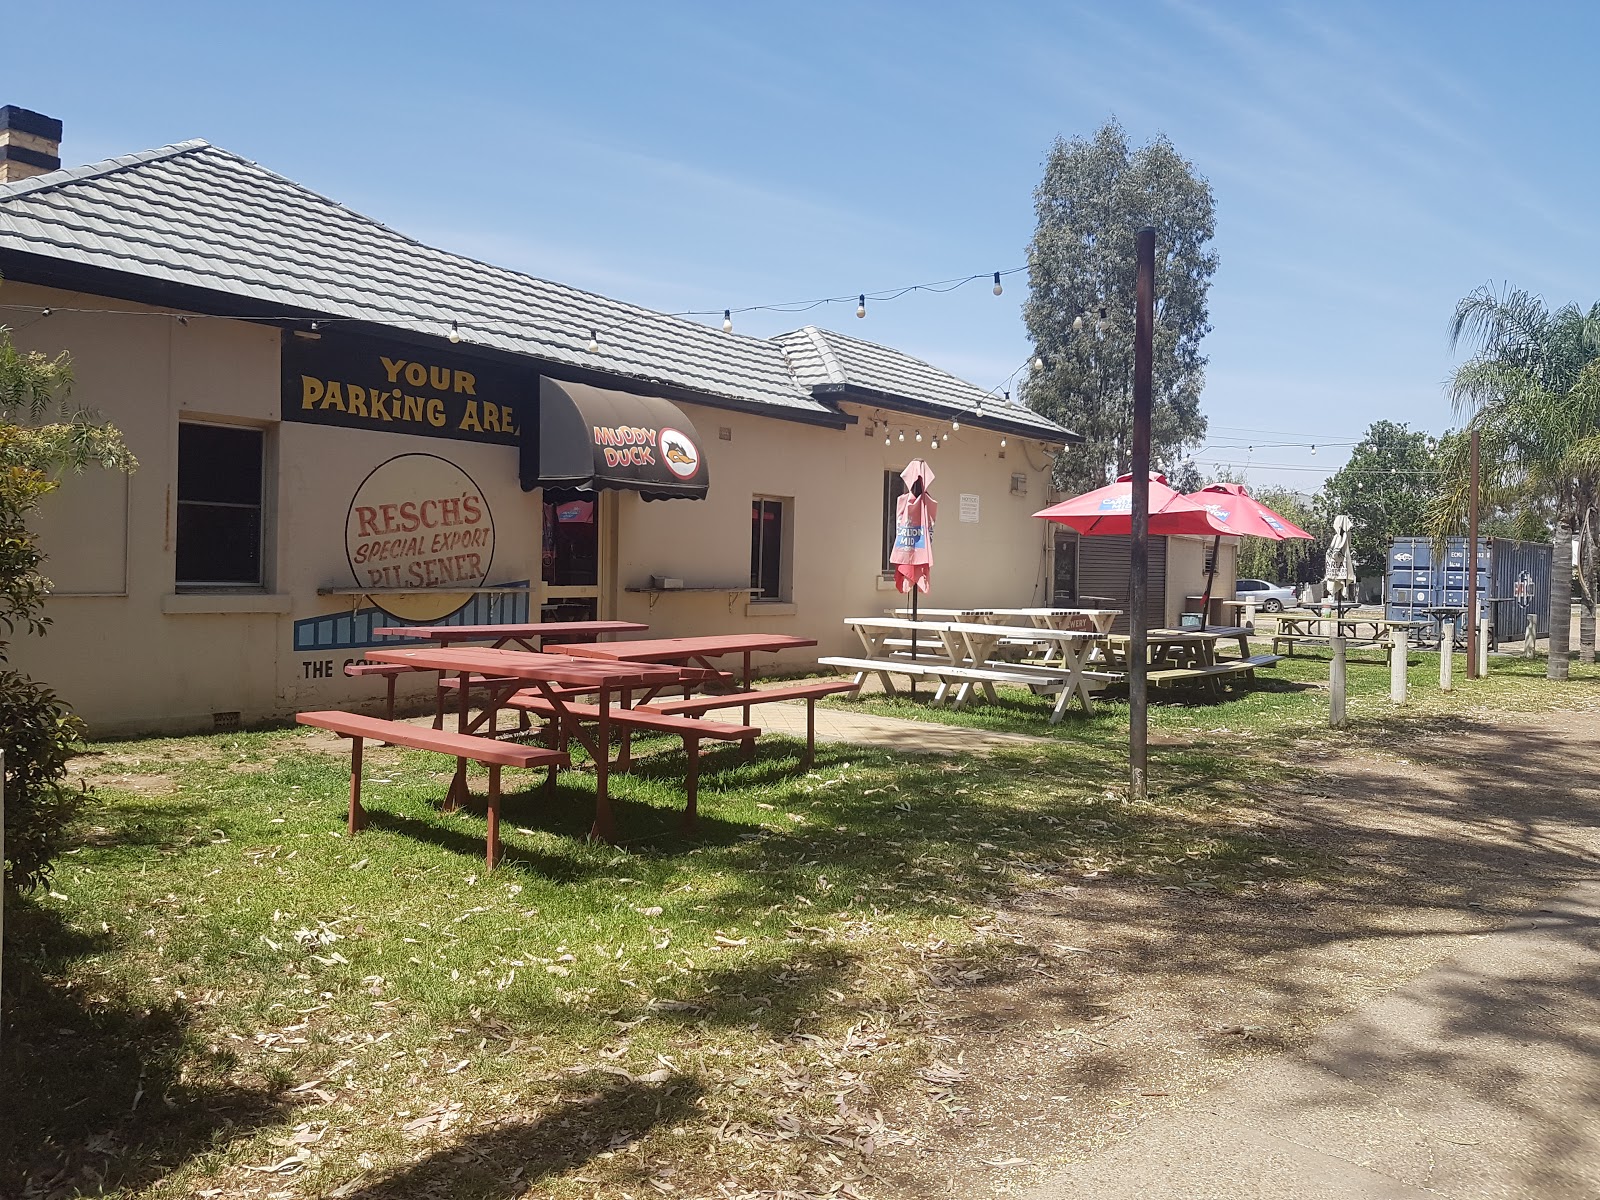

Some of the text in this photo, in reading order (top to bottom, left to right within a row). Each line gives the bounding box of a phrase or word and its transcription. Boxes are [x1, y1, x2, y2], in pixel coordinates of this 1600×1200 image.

[379, 356, 476, 395] YOUR
[458, 400, 520, 436] ARE
[593, 425, 656, 446] MUDDY
[603, 446, 656, 467] DUCK
[354, 492, 482, 537] RESCH'S
[353, 527, 491, 564] SPECIAL EXPORT
[899, 537, 915, 546] MID
[367, 552, 485, 588] PILSENER
[302, 659, 334, 679] THE
